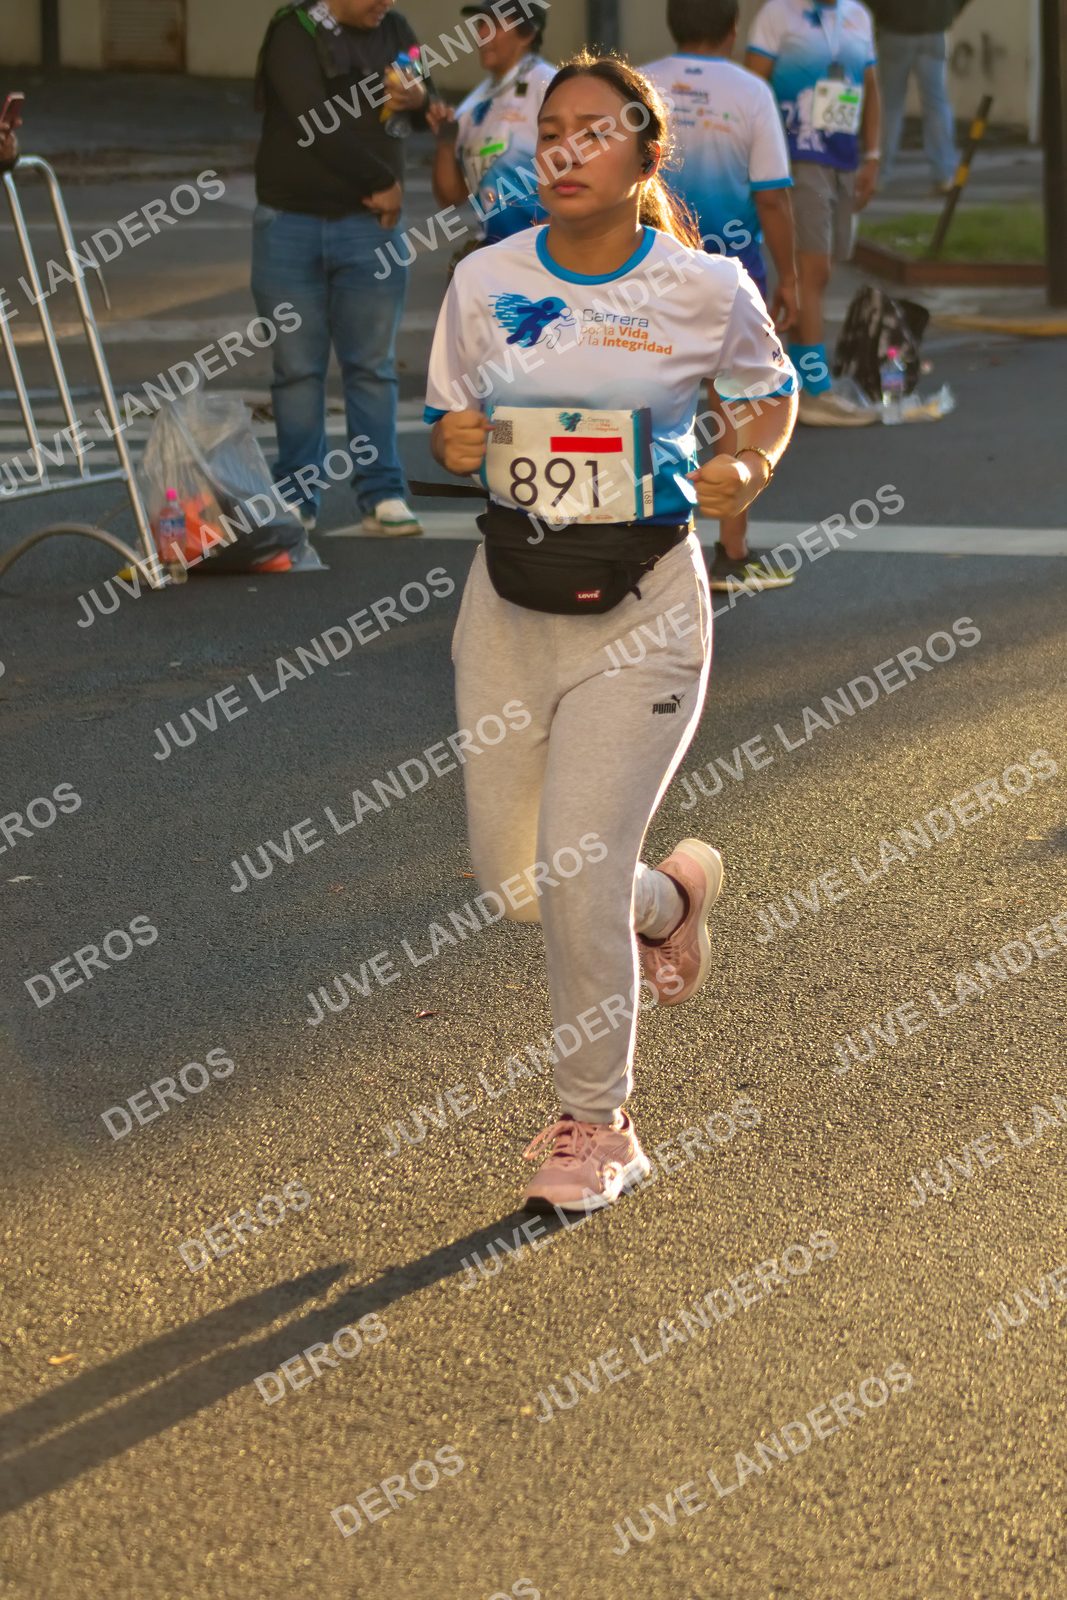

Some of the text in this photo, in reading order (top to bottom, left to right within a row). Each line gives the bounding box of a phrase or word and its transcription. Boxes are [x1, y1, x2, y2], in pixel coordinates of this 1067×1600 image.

[582, 308, 649, 328] Carrera
[604, 325, 614, 336] la
[619, 325, 649, 340] Vida
[588, 335, 599, 346] la
[602, 337, 673, 355] Integridad
[509, 457, 600, 508] 891
[652, 703, 677, 714] PUMA
